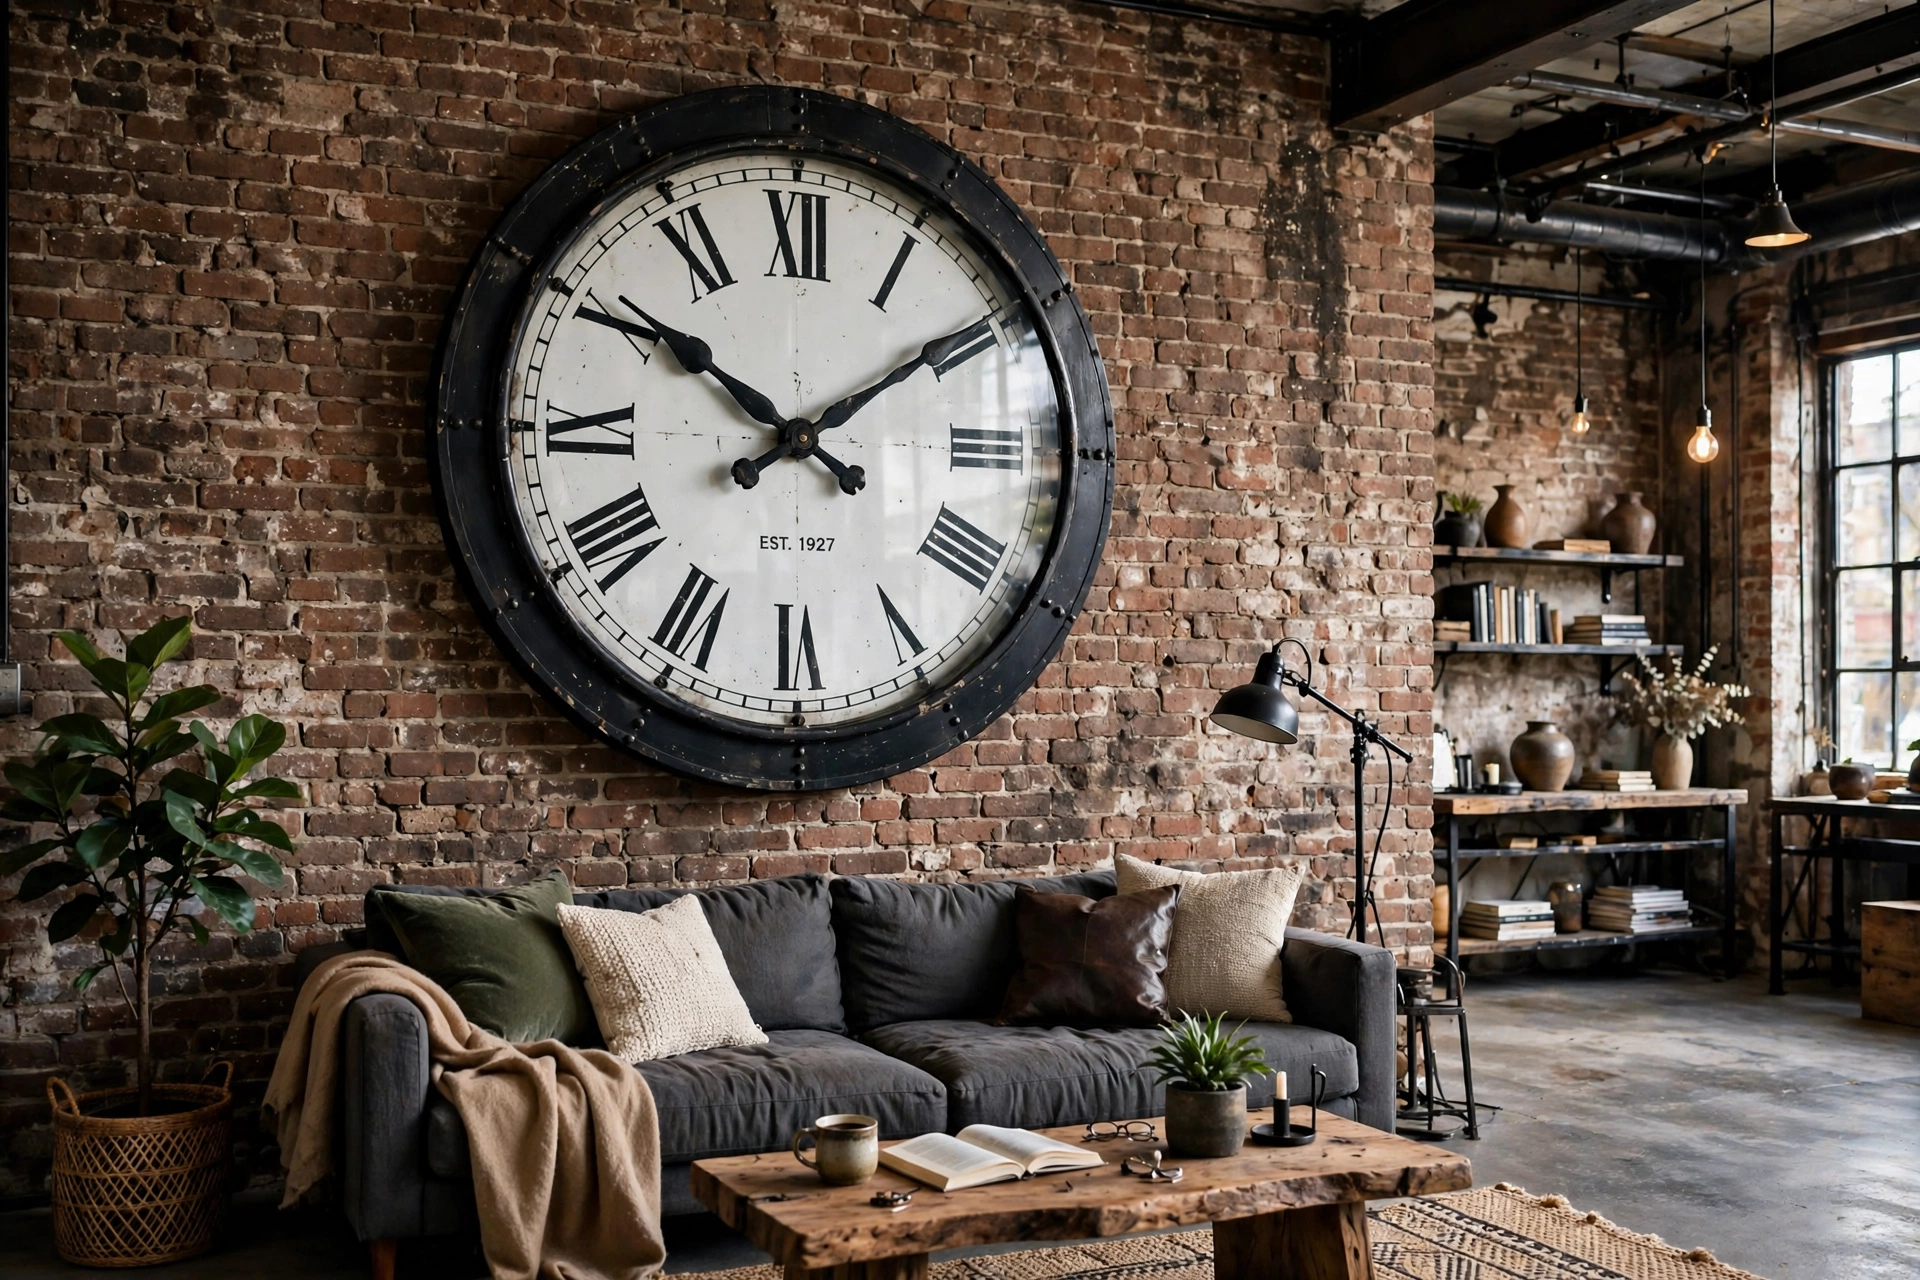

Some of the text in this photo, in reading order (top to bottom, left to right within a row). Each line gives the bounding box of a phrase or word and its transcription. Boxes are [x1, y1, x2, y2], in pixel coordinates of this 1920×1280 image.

[652, 203, 739, 305] XI
[762, 189, 831, 283] XII
[868, 231, 921, 313] I
[572, 287, 661, 365] X
[546, 400, 635, 461] IX
[949, 422, 1023, 476] III
[563, 482, 668, 596] VIII
[760, 535, 836, 552] EST. 1927
[916, 501, 1008, 596] IIII
[647, 563, 731, 674] VII
[773, 603, 827, 691] VI
[877, 584, 929, 666] V
